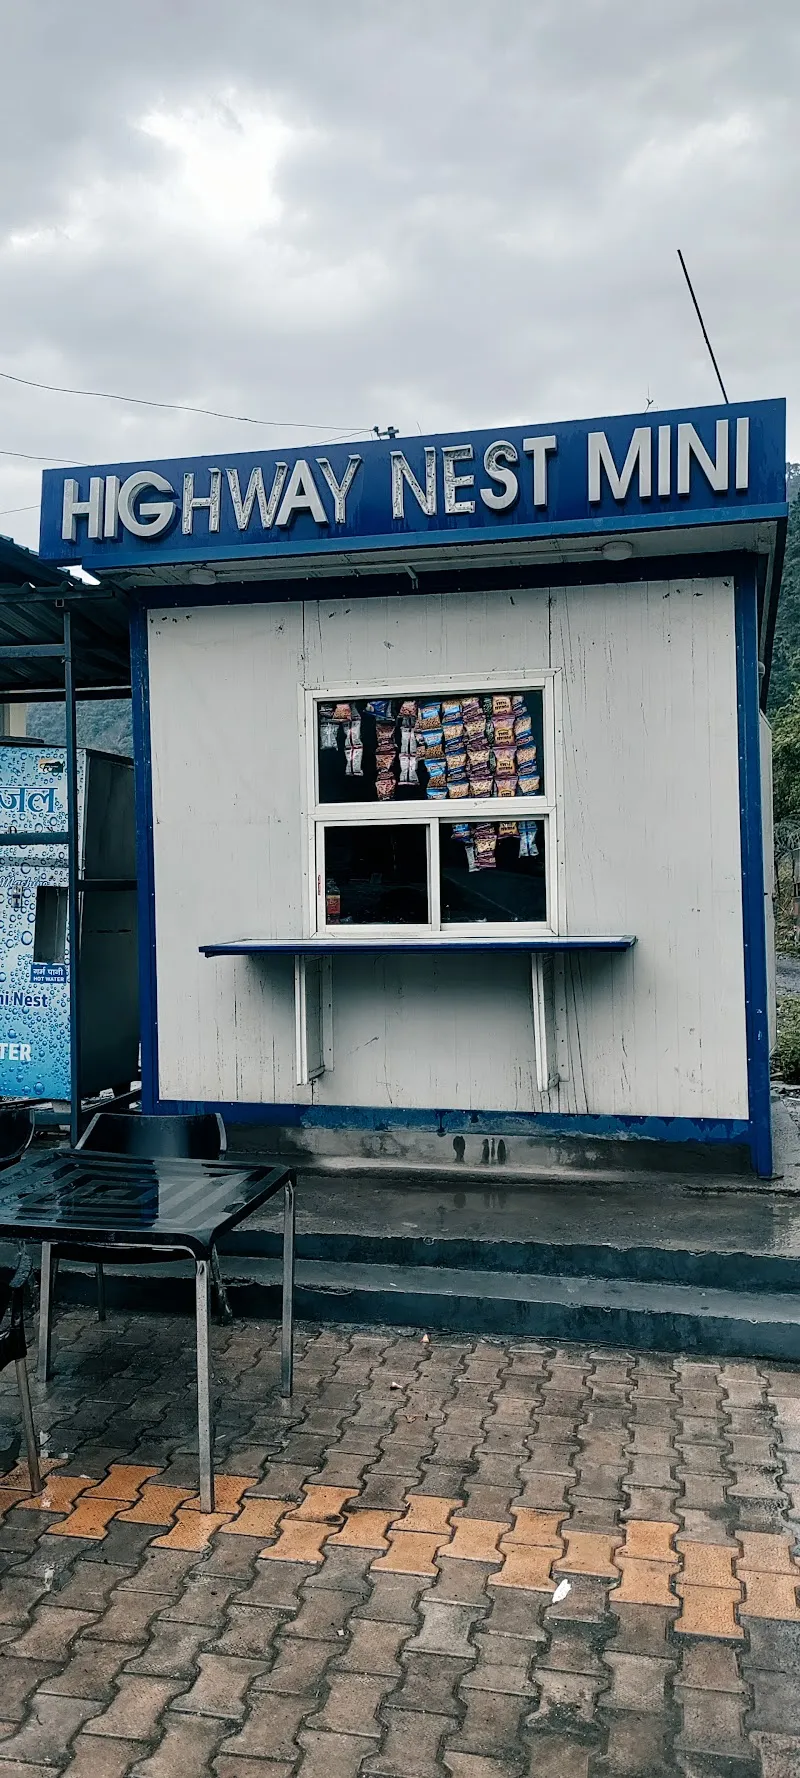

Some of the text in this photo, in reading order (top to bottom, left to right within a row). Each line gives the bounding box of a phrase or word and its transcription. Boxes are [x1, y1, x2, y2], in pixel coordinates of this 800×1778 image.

[61, 417, 750, 541] HIGHWAY NEST MINI
[13, 991, 48, 1008] Nest
